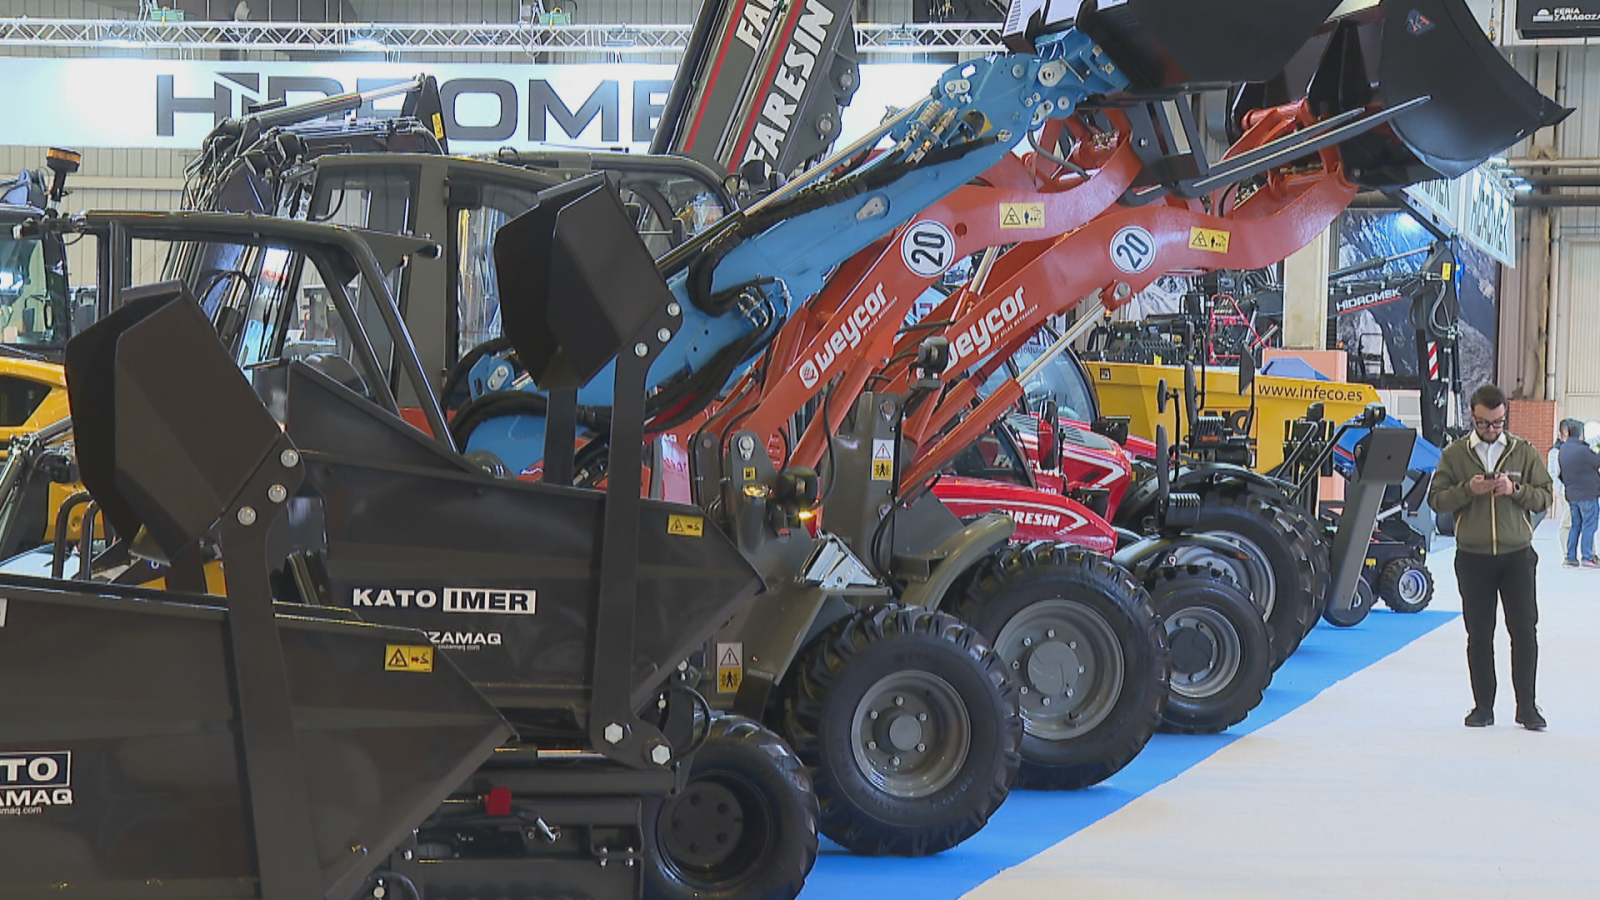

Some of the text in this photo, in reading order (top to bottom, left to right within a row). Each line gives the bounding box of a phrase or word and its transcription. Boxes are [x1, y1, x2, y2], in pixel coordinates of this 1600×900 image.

[1554, 7, 1580, 15] FERIA
[1554, 13, 1600, 21] ZARAGOZA
[740, 0, 834, 180] FARESIN
[911, 231, 945, 267] 20
[1116, 232, 1149, 269] 20
[1336, 287, 1402, 312] HIDROMEK
[815, 282, 888, 373] weycor
[1258, 383, 1363, 402] www.infeco.es
[353, 588, 529, 611] KATO IMER
